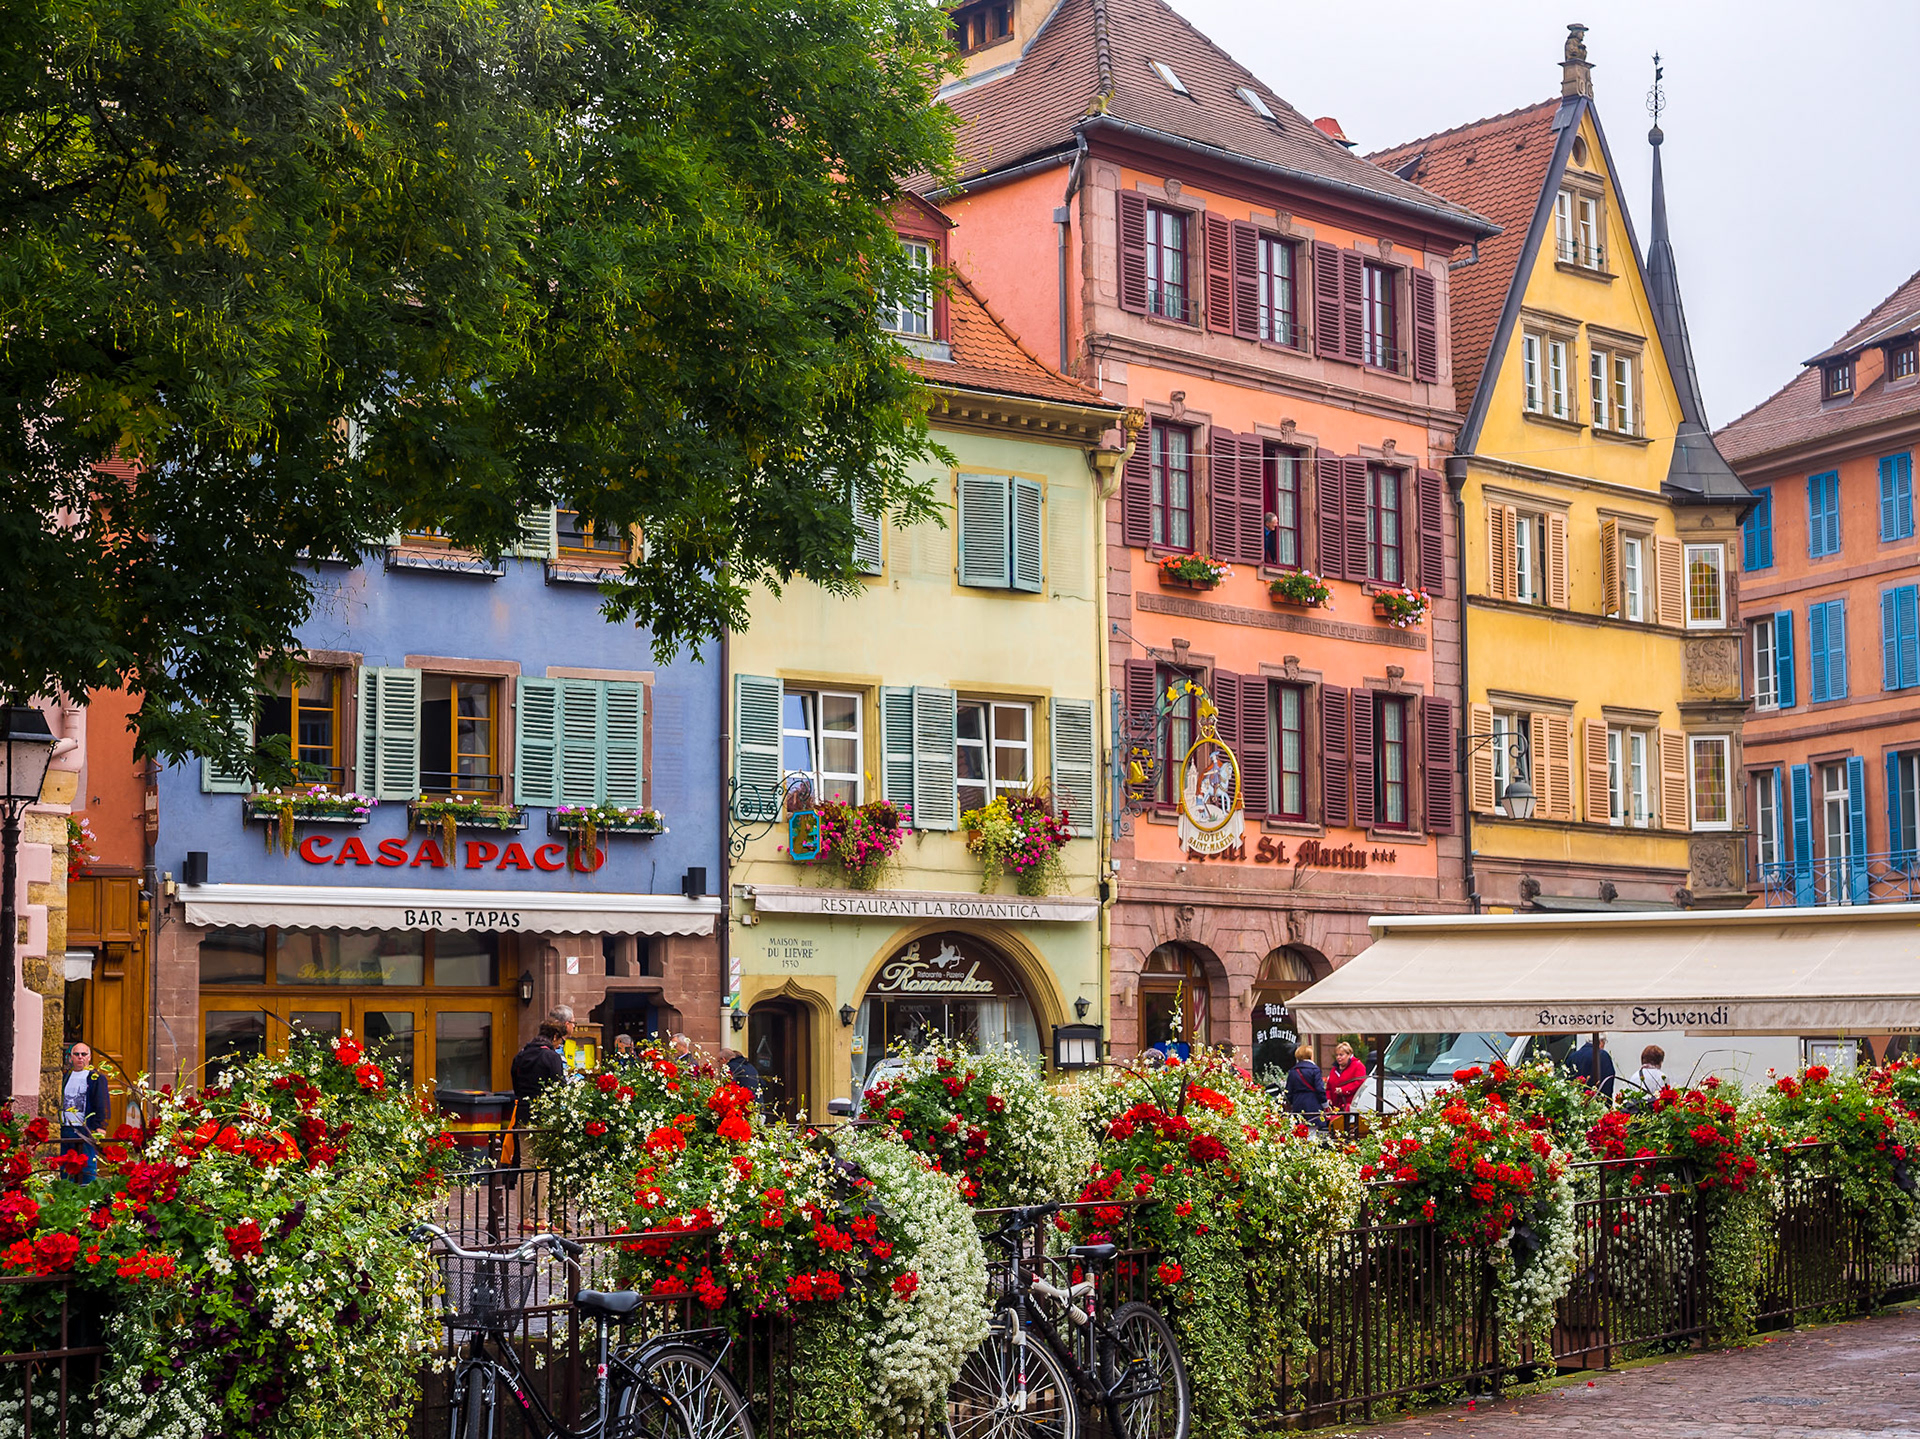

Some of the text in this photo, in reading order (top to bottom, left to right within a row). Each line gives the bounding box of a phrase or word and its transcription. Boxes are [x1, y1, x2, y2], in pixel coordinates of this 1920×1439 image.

[300, 835, 604, 873] CASA PACO
[1296, 839, 1368, 868] Martin
[821, 899, 1040, 917] RESTAURANT LA ROMANTICA
[405, 910, 442, 926] BAR
[465, 911, 520, 927] TAPAS
[769, 938, 798, 946] MAISON
[901, 941, 920, 961] La
[878, 961, 993, 992] Romantica
[1536, 1007, 1728, 1029] Brasserie Schwendi
[1270, 1026, 1297, 1044] Martin
